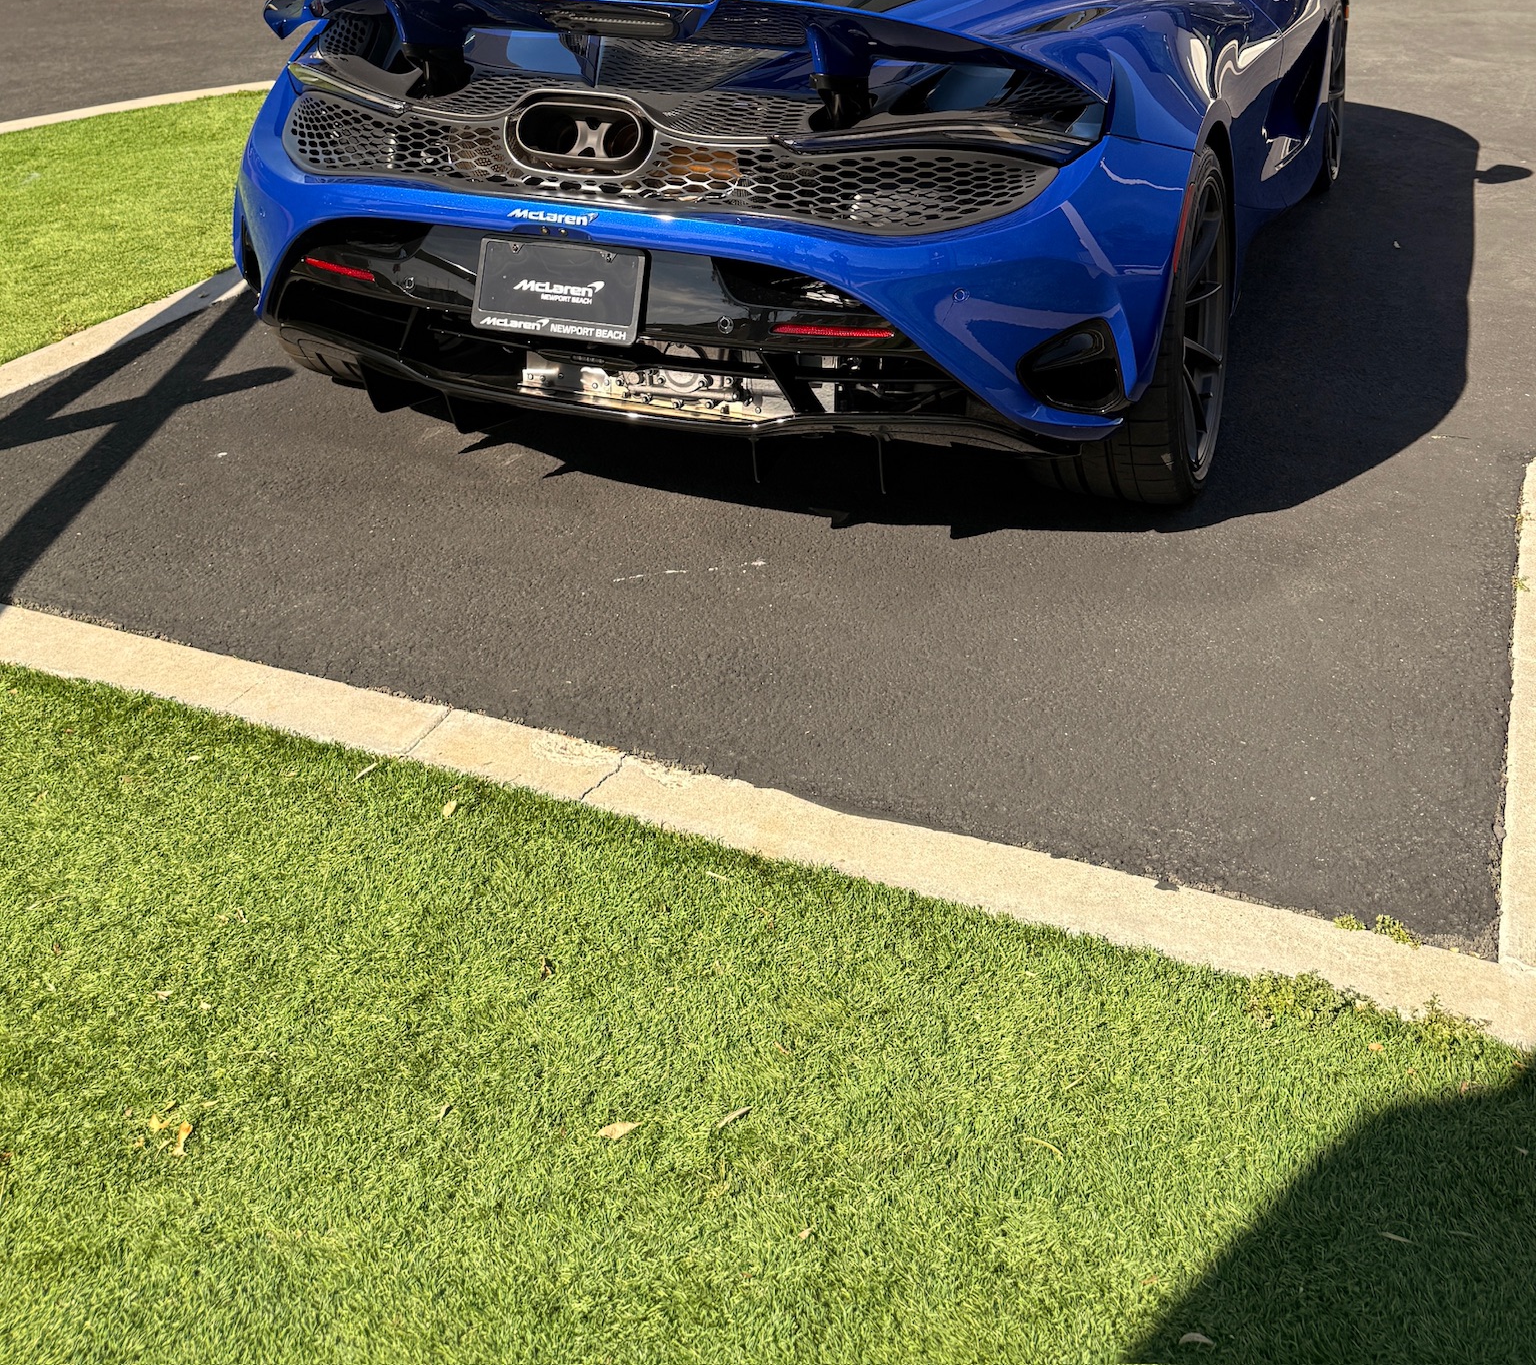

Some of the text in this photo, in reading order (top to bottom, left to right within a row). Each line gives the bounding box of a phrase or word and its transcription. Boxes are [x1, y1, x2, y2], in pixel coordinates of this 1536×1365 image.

[507, 208, 588, 226] McLaren
[513, 279, 593, 297] McLaren
[541, 293, 593, 305] NEWPORT BEACH
[480, 316, 627, 341] McLaren NEWPORT BEACH
